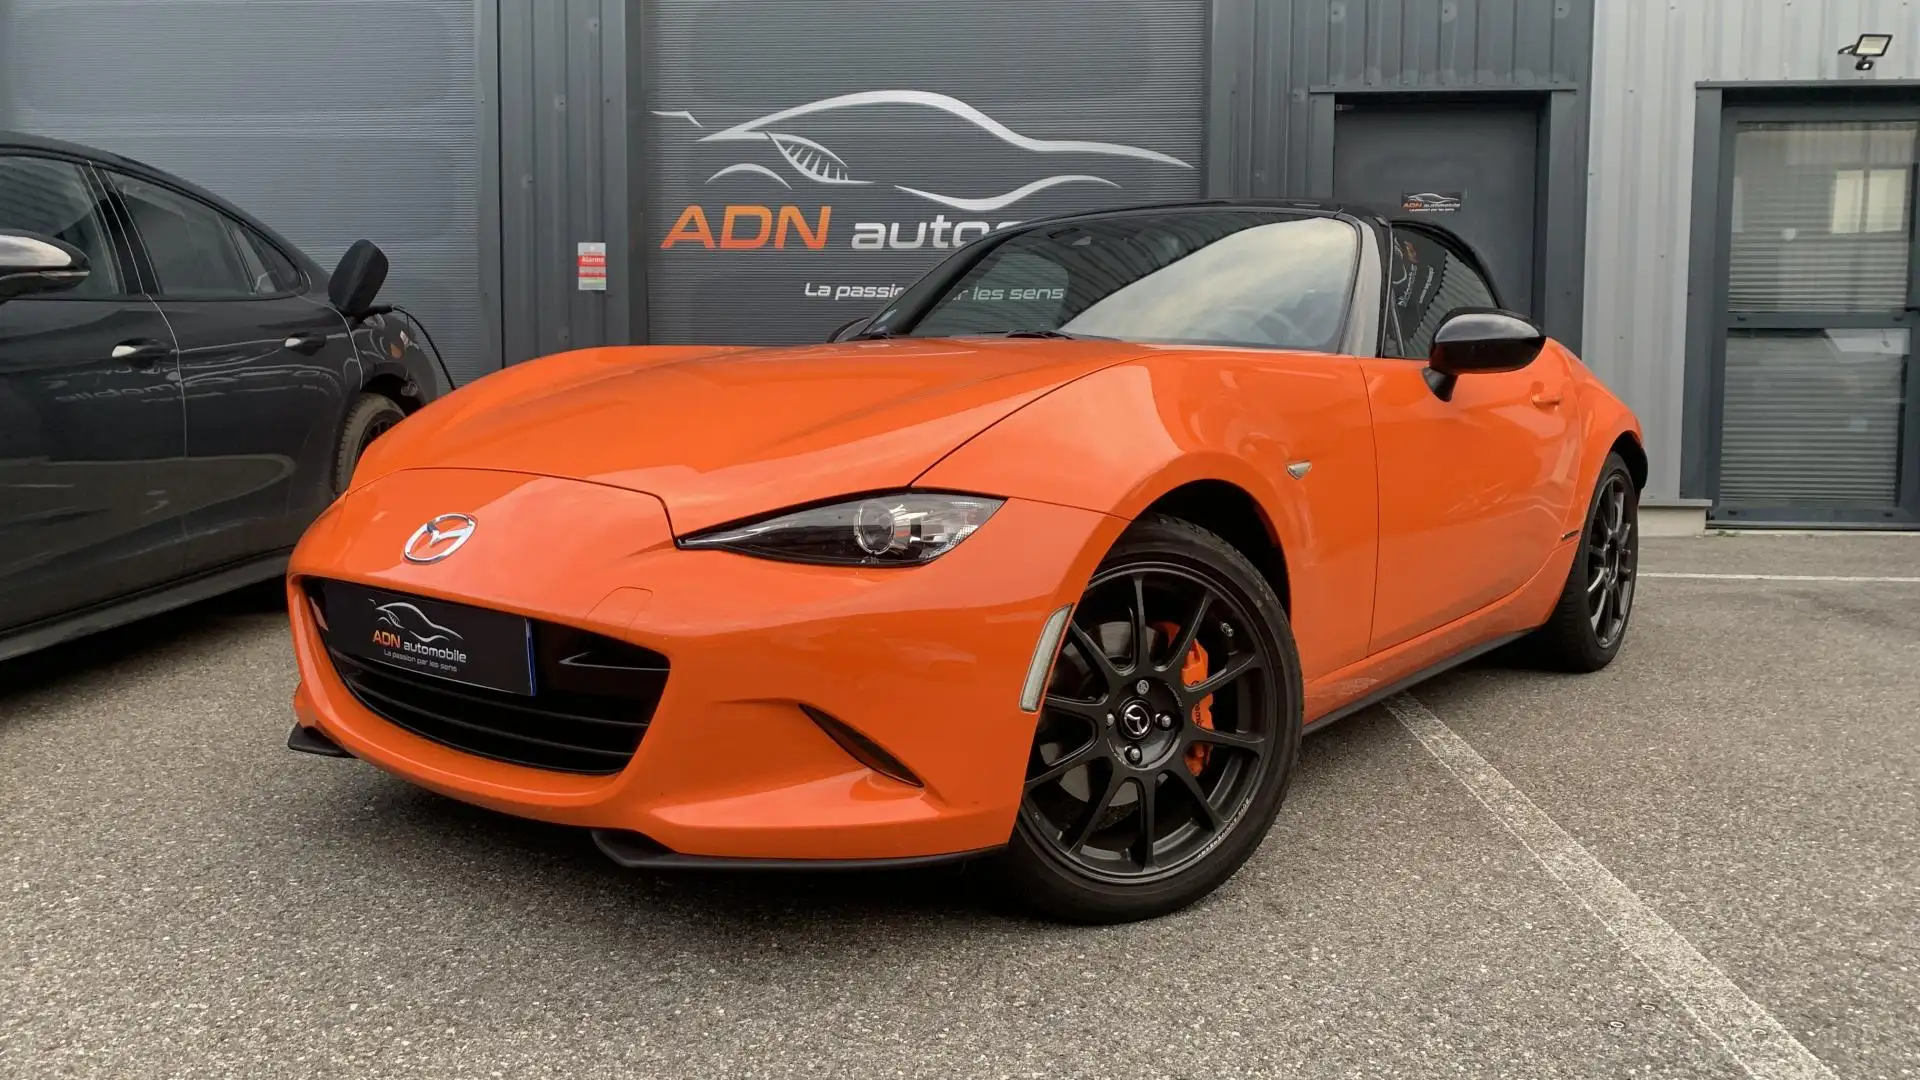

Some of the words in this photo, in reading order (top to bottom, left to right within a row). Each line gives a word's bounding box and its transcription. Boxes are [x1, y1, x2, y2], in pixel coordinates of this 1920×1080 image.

[659, 205, 832, 250] ADN
[851, 214, 1023, 250] auto
[804, 282, 831, 297] La
[973, 286, 1004, 301] les
[1009, 288, 1065, 300] sens
[373, 629, 400, 648] ADN
[403, 641, 467, 663] automobile
